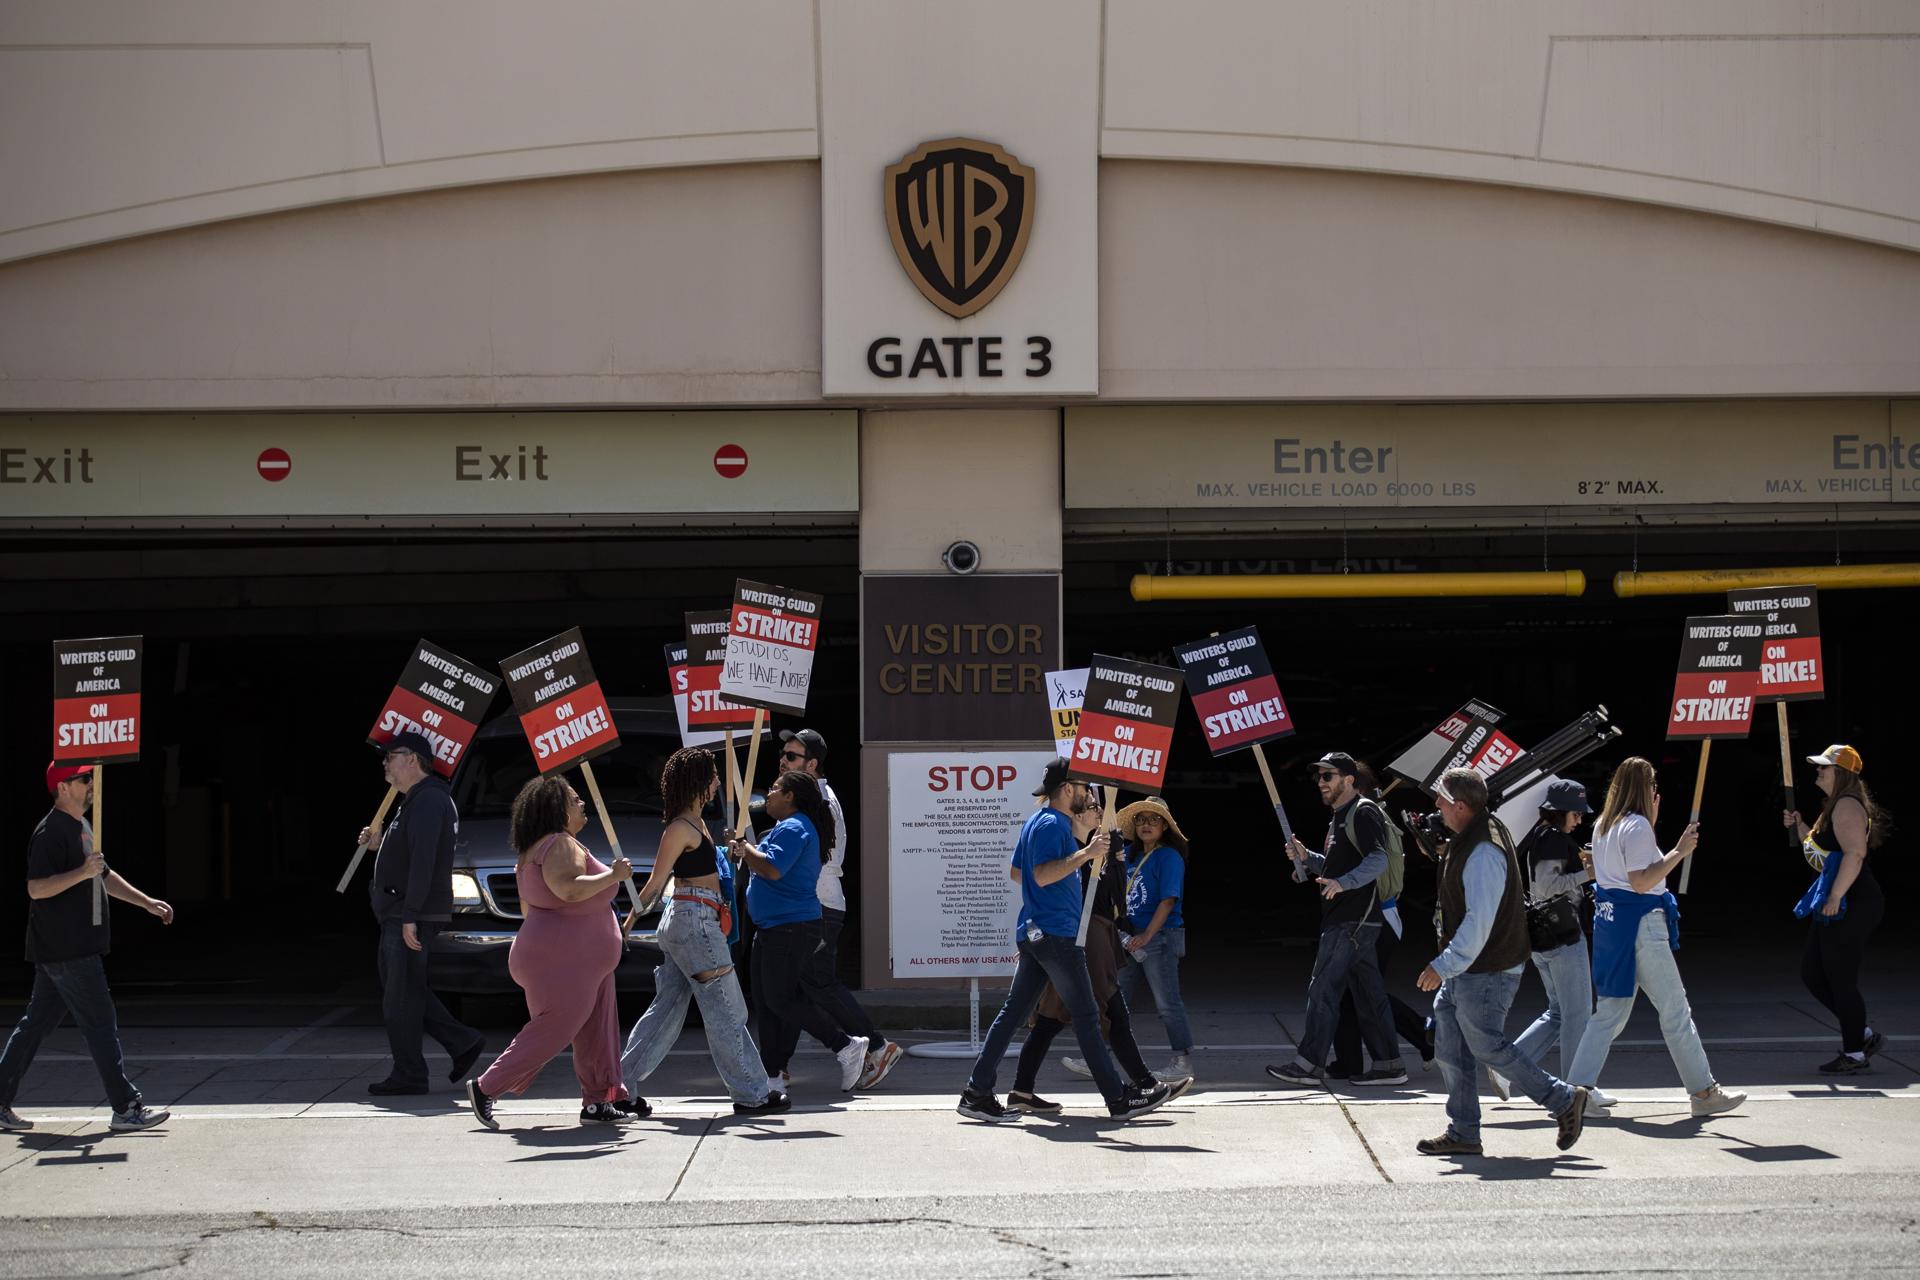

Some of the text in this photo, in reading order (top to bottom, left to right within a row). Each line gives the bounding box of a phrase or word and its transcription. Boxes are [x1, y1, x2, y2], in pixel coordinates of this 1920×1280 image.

[867, 336, 1052, 378] GATE 3
[456, 446, 548, 480] Exit
[1274, 439, 1392, 473] Enter
[0, 449, 93, 483] Exit
[1197, 482, 1476, 497] MAX. VEHICLE LOAD 6000 LBS
[1618, 481, 1663, 494] MAX.
[1766, 478, 1892, 493] MAX. VEHICLE
[741, 589, 815, 613] WRITERS GUILD
[1734, 597, 1810, 612] WRITERS GUILD
[772, 608, 782, 616] ON
[1768, 613, 1778, 621] OF
[691, 622, 730, 635] WRITERS
[736, 611, 812, 646] STRIKE!
[1690, 626, 1761, 638] WRITERS GUILD
[884, 624, 1042, 654] VISITOR
[1718, 642, 1728, 651] OF
[60, 649, 135, 664] WRITERS GUILD
[1181, 643, 1226, 664] WRITERS
[1227, 636, 1256, 651] GUILD
[1767, 647, 1785, 659] ON
[509, 642, 580, 682] WRITERS GUILD
[1219, 657, 1229, 667] OF
[1698, 655, 1742, 667] AMERICA
[93, 667, 104, 676] OF
[419, 649, 493, 694] WRITERS GUILD
[544, 669, 554, 680] OF
[728, 662, 778, 684] WE HAVE
[880, 663, 1042, 694] CENTER
[1095, 667, 1175, 692] WRITERS GUILD
[1207, 665, 1252, 686] AMERICA
[1760, 659, 1816, 684] RIKE!
[76, 678, 120, 692] AMERICA
[443, 679, 456, 690] OF
[534, 675, 576, 702] AMERICA
[1708, 680, 1726, 694] ON
[419, 682, 464, 711] AMERICA
[1126, 689, 1138, 699] OF
[1229, 690, 1248, 705] ON
[90, 704, 107, 717] ON
[555, 702, 575, 720] ON
[1104, 699, 1152, 718] AMERICA
[1205, 697, 1285, 738] STRIKE!
[1674, 696, 1751, 722] STRIKE!
[422, 710, 442, 727] ON
[59, 718, 135, 746] STRIKE!
[534, 706, 609, 759] STRIKE!
[1115, 725, 1134, 741] ON
[1462, 726, 1487, 754] GUILD
[1076, 737, 1162, 774] STRIKE!
[928, 765, 1017, 791] STOP
[1128, 1098, 1148, 1106] HOKA
